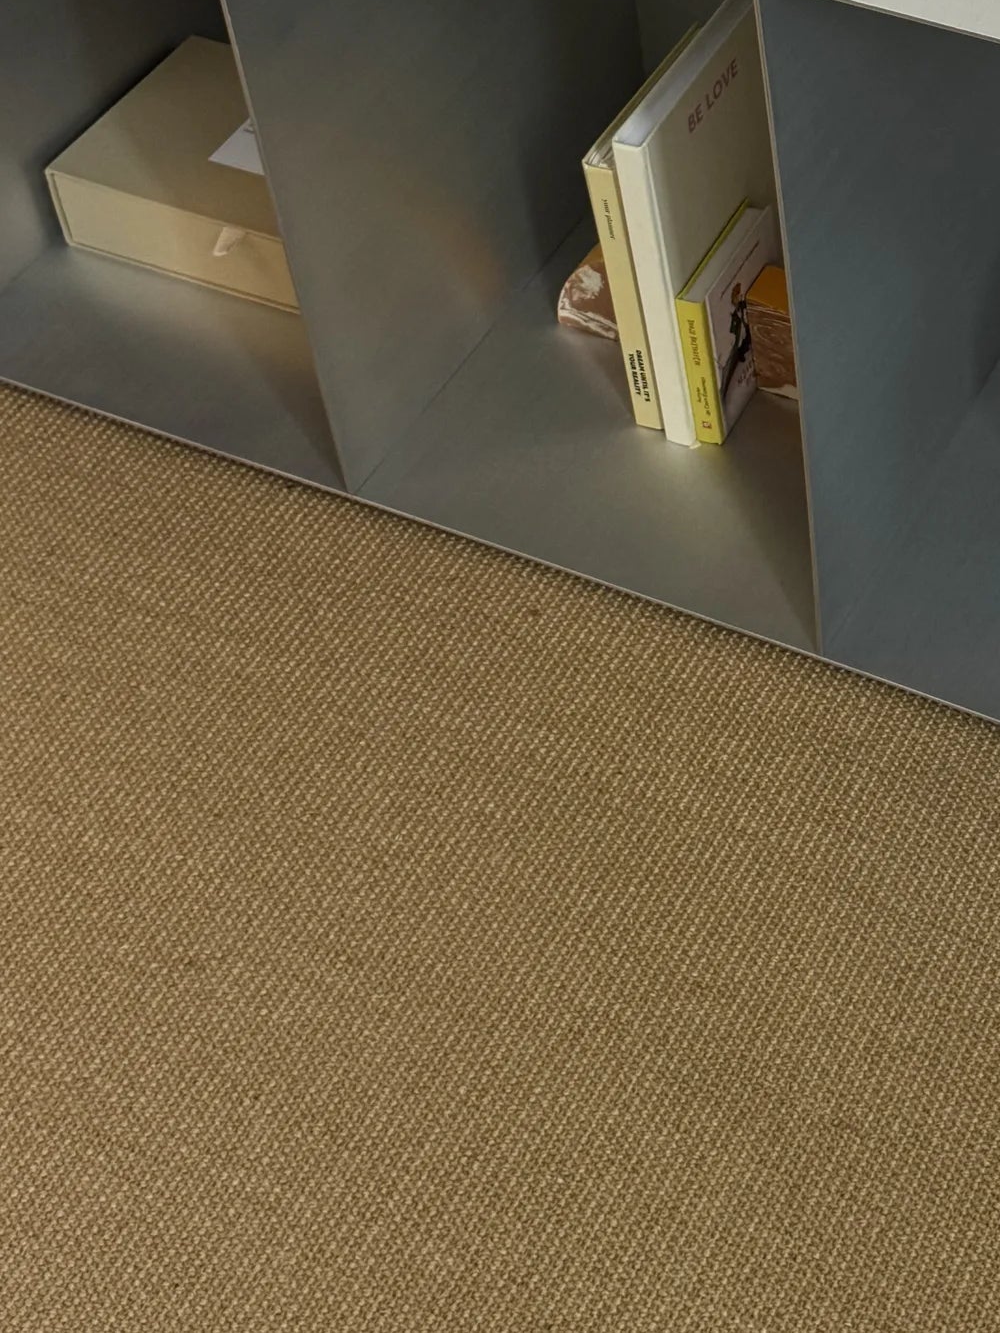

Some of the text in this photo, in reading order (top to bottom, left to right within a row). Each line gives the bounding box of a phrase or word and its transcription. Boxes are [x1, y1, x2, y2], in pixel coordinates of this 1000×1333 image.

[688, 57, 738, 134] BE LOVE
[628, 353, 641, 396] YOUR REALITY
[636, 349, 645, 372] DREAM
